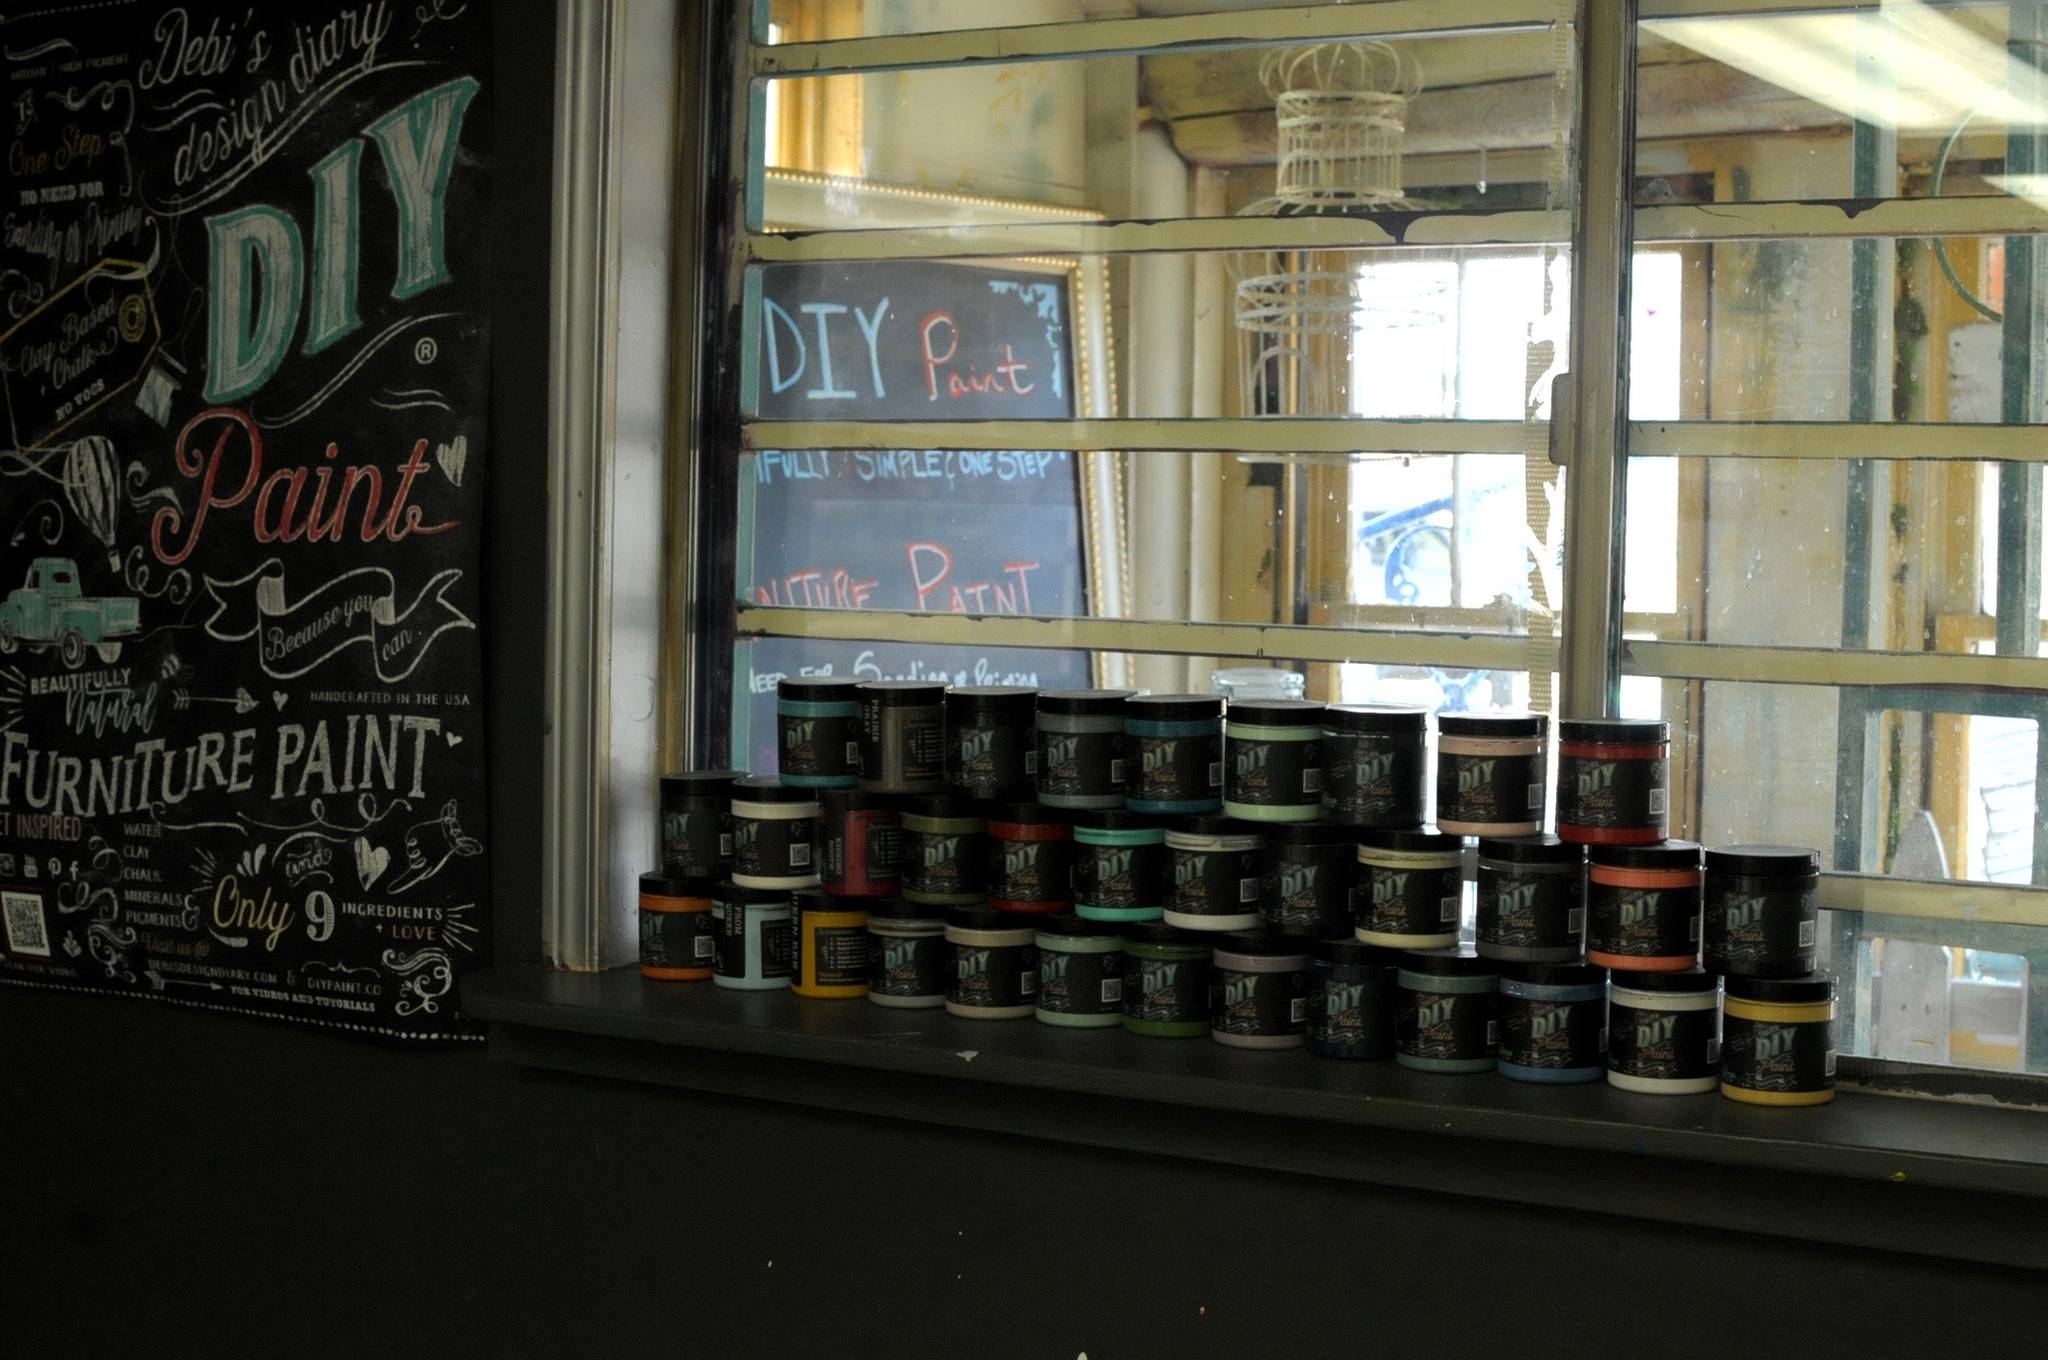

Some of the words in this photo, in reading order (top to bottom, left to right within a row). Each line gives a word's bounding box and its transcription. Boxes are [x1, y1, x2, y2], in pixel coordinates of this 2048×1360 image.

[138, 7, 272, 90] Debi's
[174, 79, 286, 186] design
[289, 0, 394, 93] diary
[202, 75, 481, 404] DIY
[762, 296, 890, 399] DIY
[920, 311, 1034, 402] Paint
[151, 404, 459, 567] Paint
[265, 604, 343, 662] Because
[343, 594, 374, 628] you
[30, 667, 132, 696] BEAUTIFULLY
[65, 682, 158, 740] Natural
[397, 692, 410, 705] IN
[416, 692, 439, 706] THE
[445, 693, 471, 706] USA
[786, 720, 816, 749] DIY
[961, 730, 994, 761] DIY
[0, 727, 258, 820] FURNITURE
[270, 714, 442, 800] PAINT
[1048, 737, 1079, 769] DIY
[1142, 740, 1178, 773] DIY
[1237, 744, 1271, 776] DIY
[1356, 752, 1395, 785] DIY
[1458, 759, 1497, 792] DIY
[1577, 763, 1617, 796] DIY
[17, 814, 82, 843] INSPIRED
[123, 823, 162, 838] WATER
[123, 845, 150, 859] CLAY
[924, 837, 960, 867] DIY
[1005, 843, 1040, 874] DIY
[1098, 849, 1134, 881] DIY
[123, 867, 163, 883] CHALK
[1174, 855, 1208, 886] DIY
[1281, 864, 1319, 897] DIY
[124, 889, 183, 907] MINERALS
[1372, 872, 1410, 904] DIY
[1499, 882, 1538, 915] DIY
[125, 910, 183, 929] PIGMENTS
[213, 874, 296, 952] Only
[305, 890, 336, 943] 9
[342, 902, 443, 922] INGREDIENTS
[1620, 891, 1662, 926] DIY
[1727, 896, 1768, 931] DIY
[391, 925, 437, 942] LOVE
[884, 940, 918, 970] DIY
[958, 950, 991, 979] DIY
[1041, 955, 1073, 984] DIY
[1142, 962, 1179, 994] DIY
[1225, 975, 1259, 1006] DIY
[315, 995, 377, 1014] TUTORIALS
[1327, 985, 1365, 1015] DIY
[1417, 997, 1456, 1029] DIY
[1531, 1006, 1573, 1039] DIY
[1636, 1014, 1678, 1048] DIY
[1755, 1026, 1799, 1061] DIY
